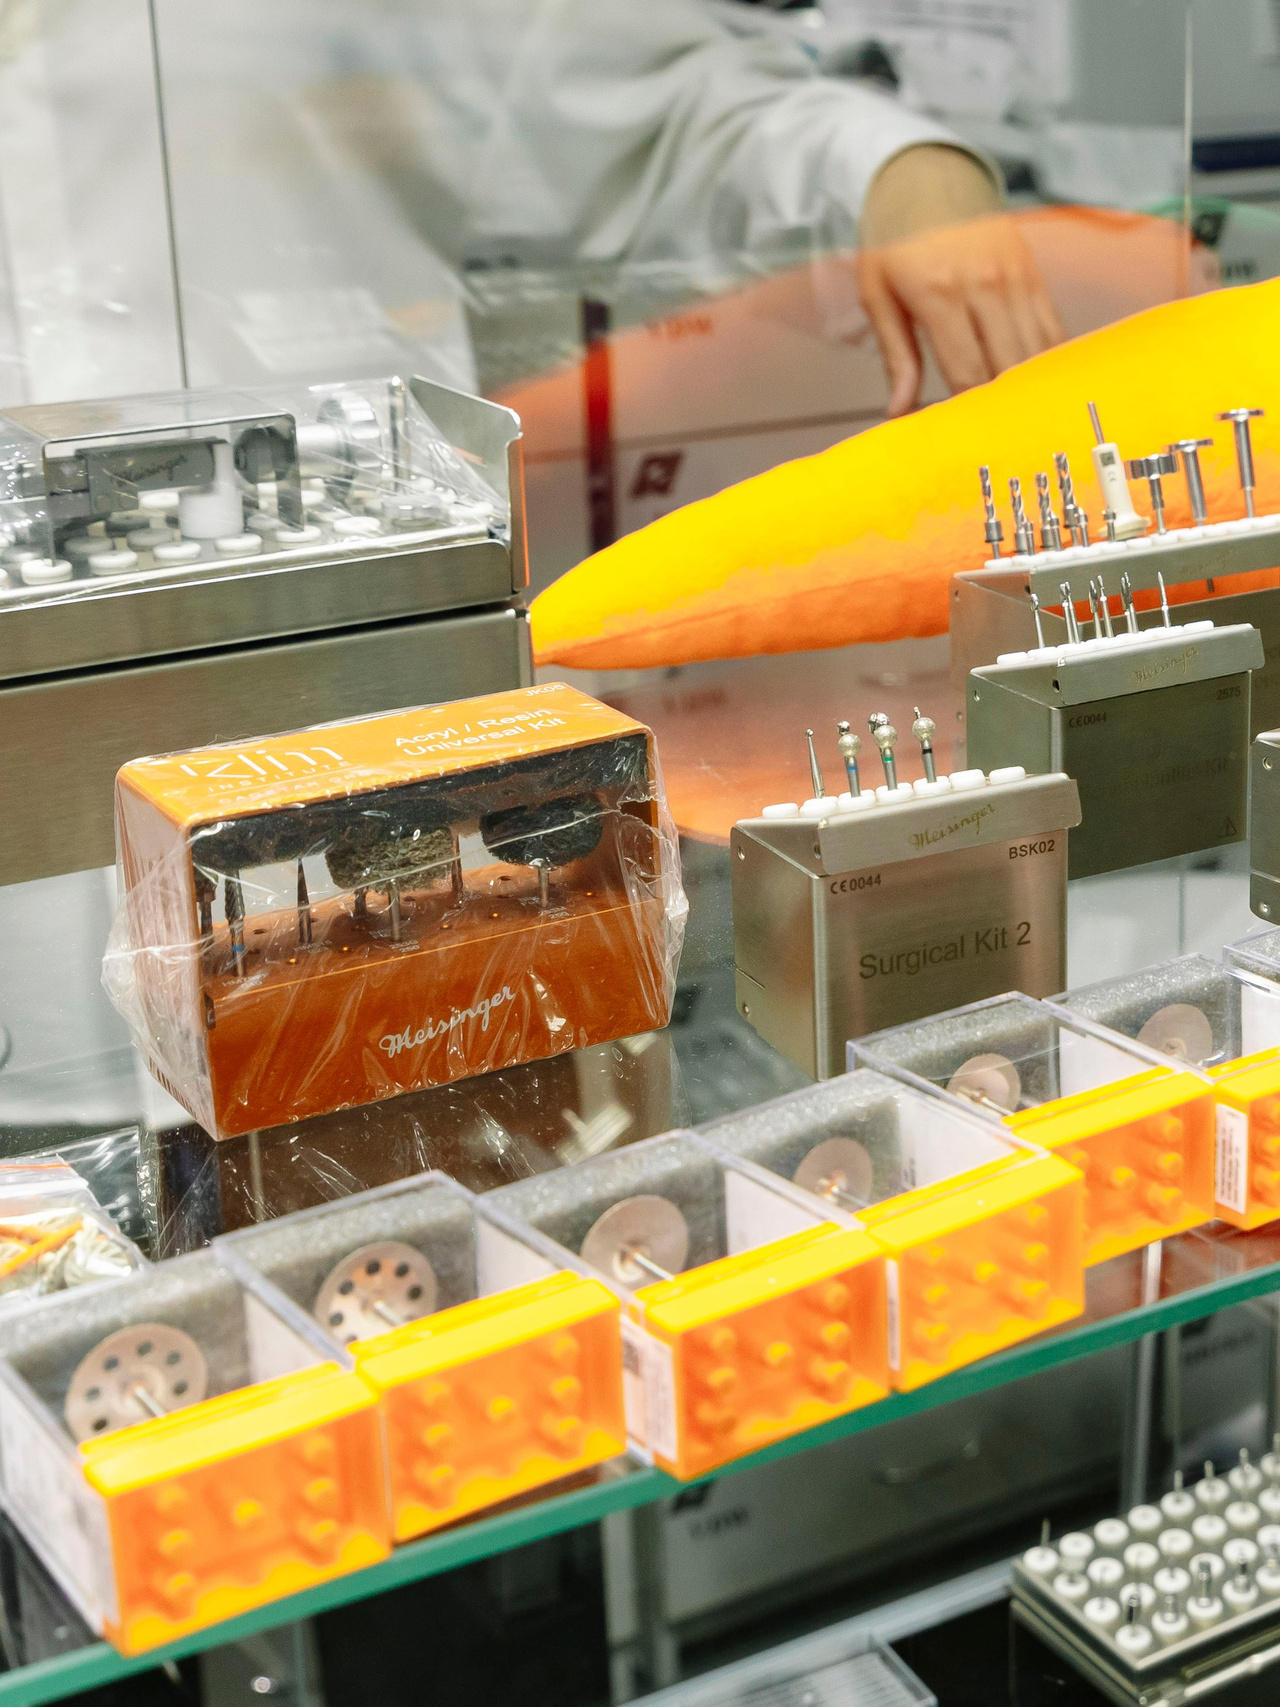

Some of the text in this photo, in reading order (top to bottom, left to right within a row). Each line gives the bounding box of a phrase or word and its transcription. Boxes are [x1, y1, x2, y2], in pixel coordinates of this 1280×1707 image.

[394, 727, 459, 747] Acryl
[476, 708, 553, 730] Resin
[402, 717, 568, 756] Universal Kit
[207, 760, 352, 793] INSTITUTE
[908, 803, 997, 851] Meisinger
[1008, 839, 1056, 860] BSK02
[858, 921, 1033, 981] Surgical Kit 2
[378, 984, 517, 1059] Meisinger
